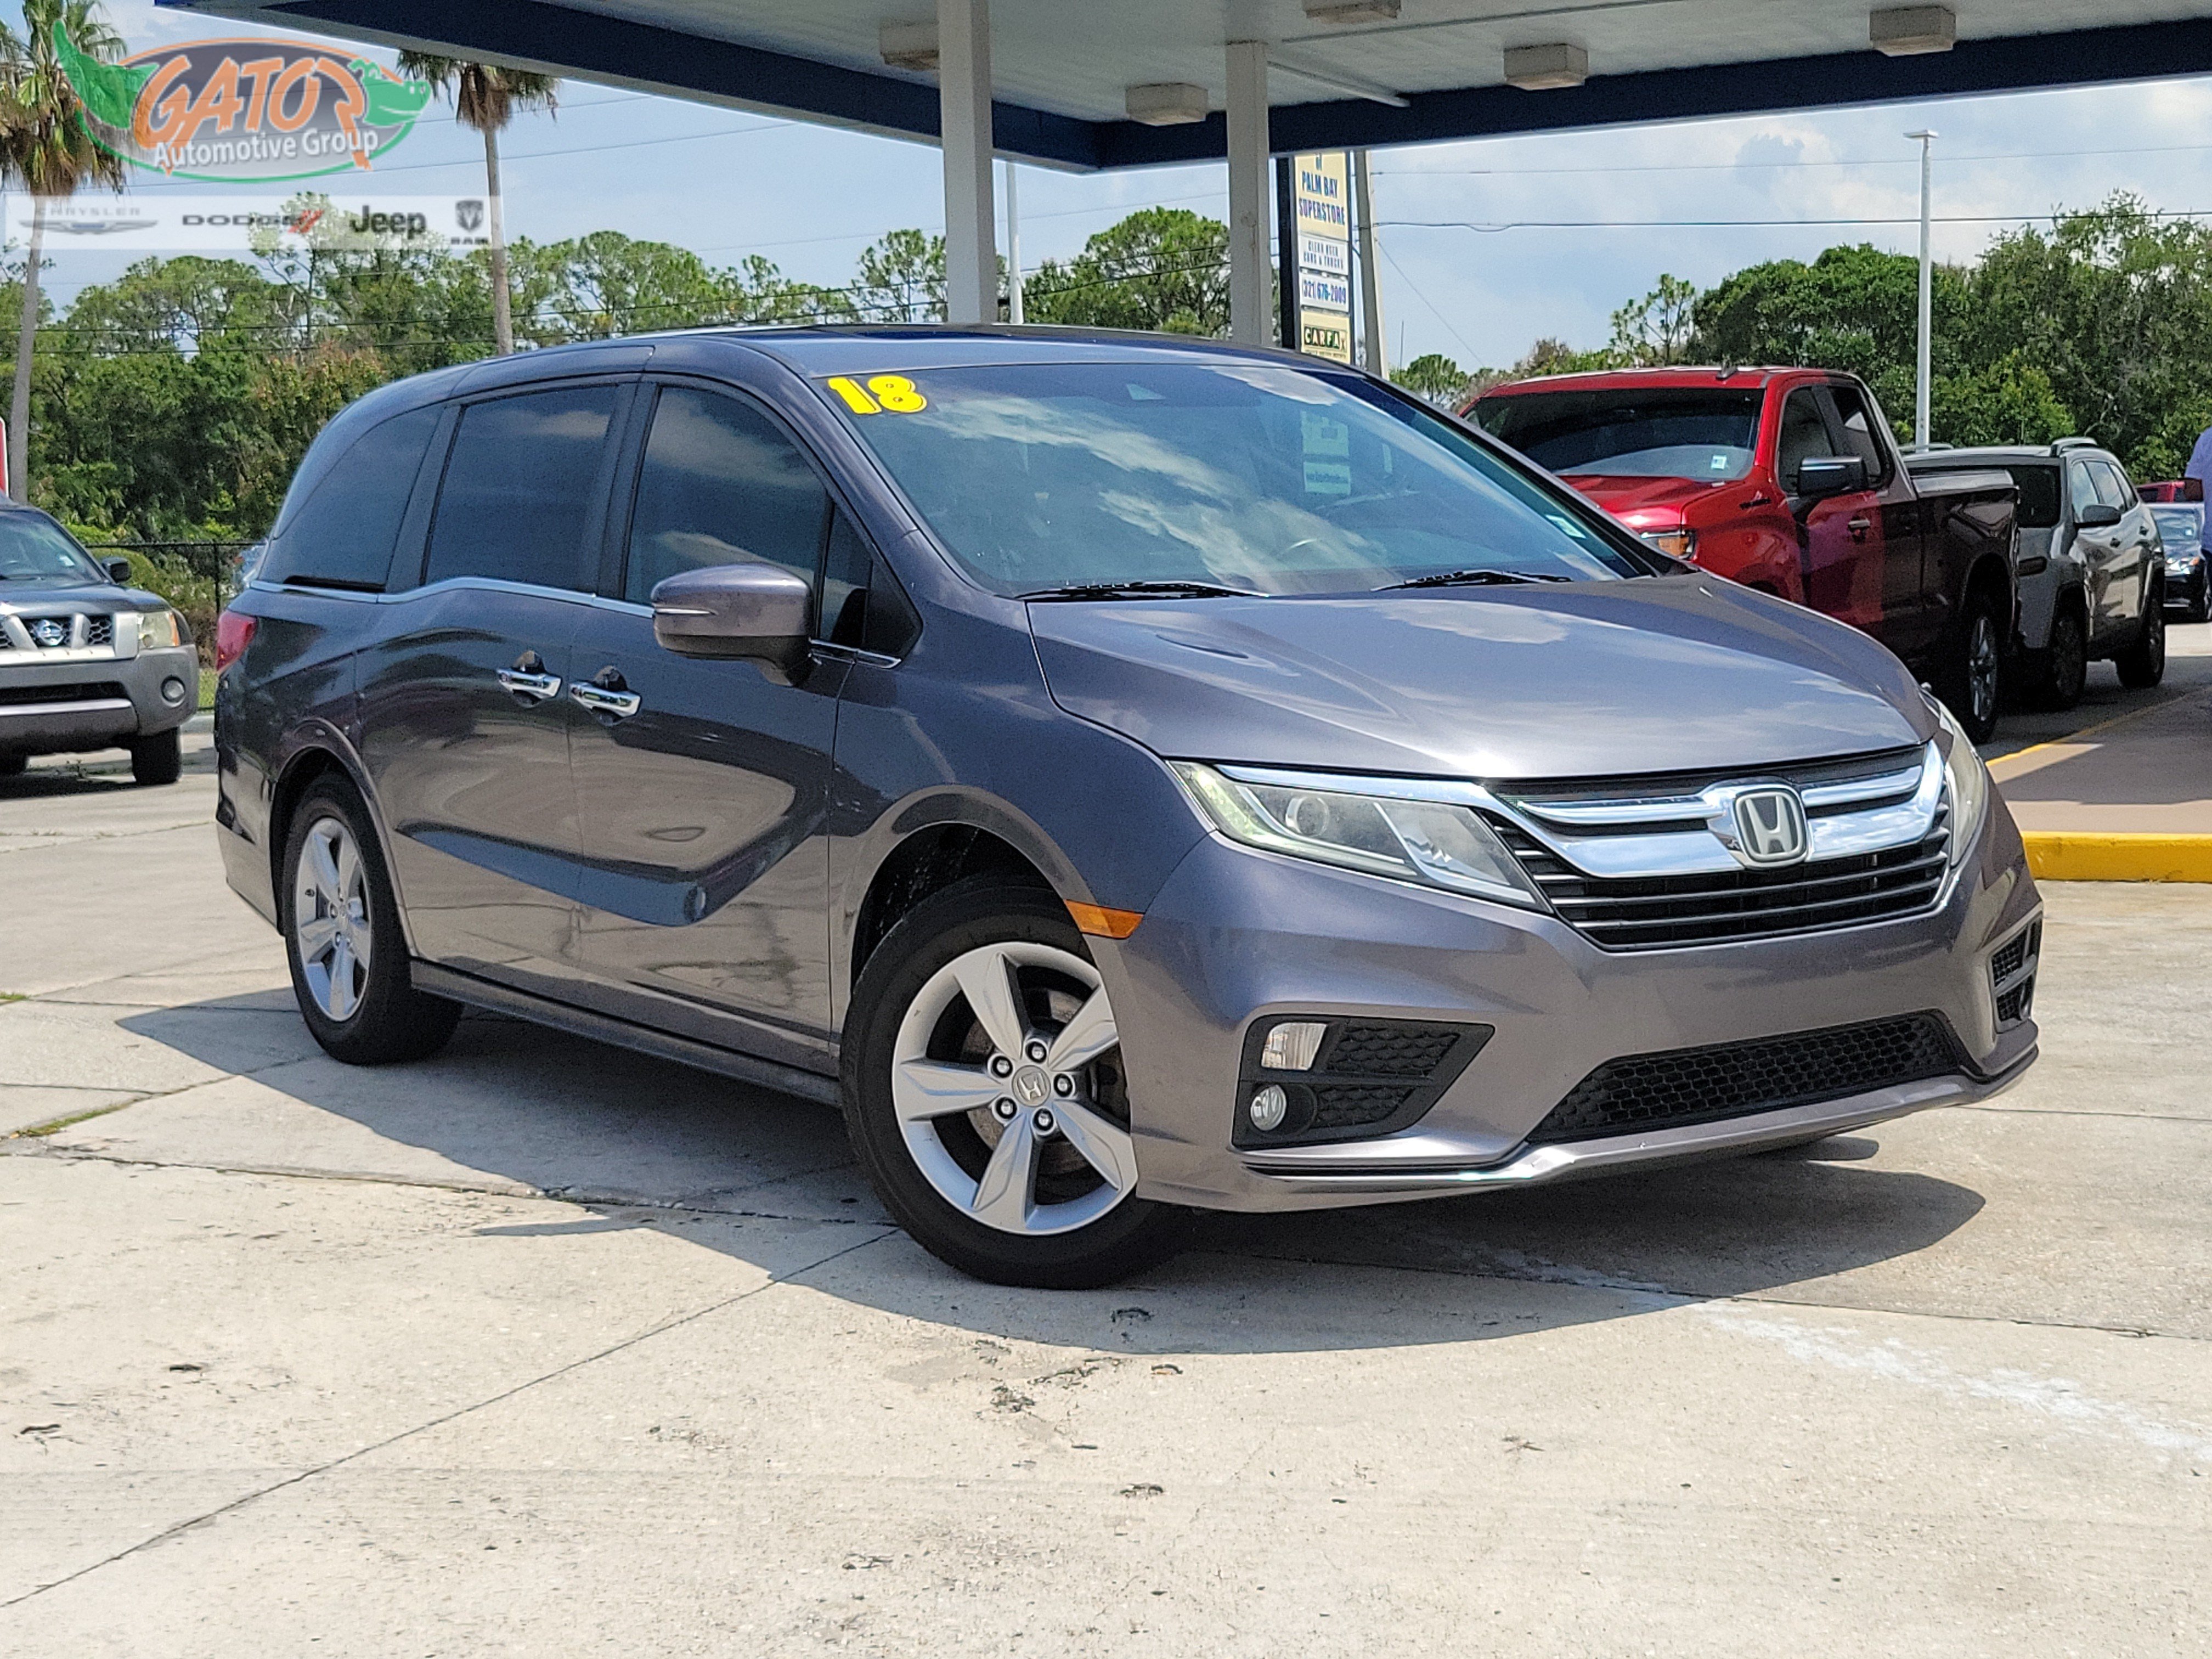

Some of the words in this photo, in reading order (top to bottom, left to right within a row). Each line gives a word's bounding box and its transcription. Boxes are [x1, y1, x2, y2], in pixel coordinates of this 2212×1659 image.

[1301, 171, 1322, 195] PALM
[1324, 176, 1338, 199] BAY
[1299, 198, 1345, 225] SUPERSTORE
[1305, 326, 1346, 352] CARFAX
[828, 375, 927, 414] 18
